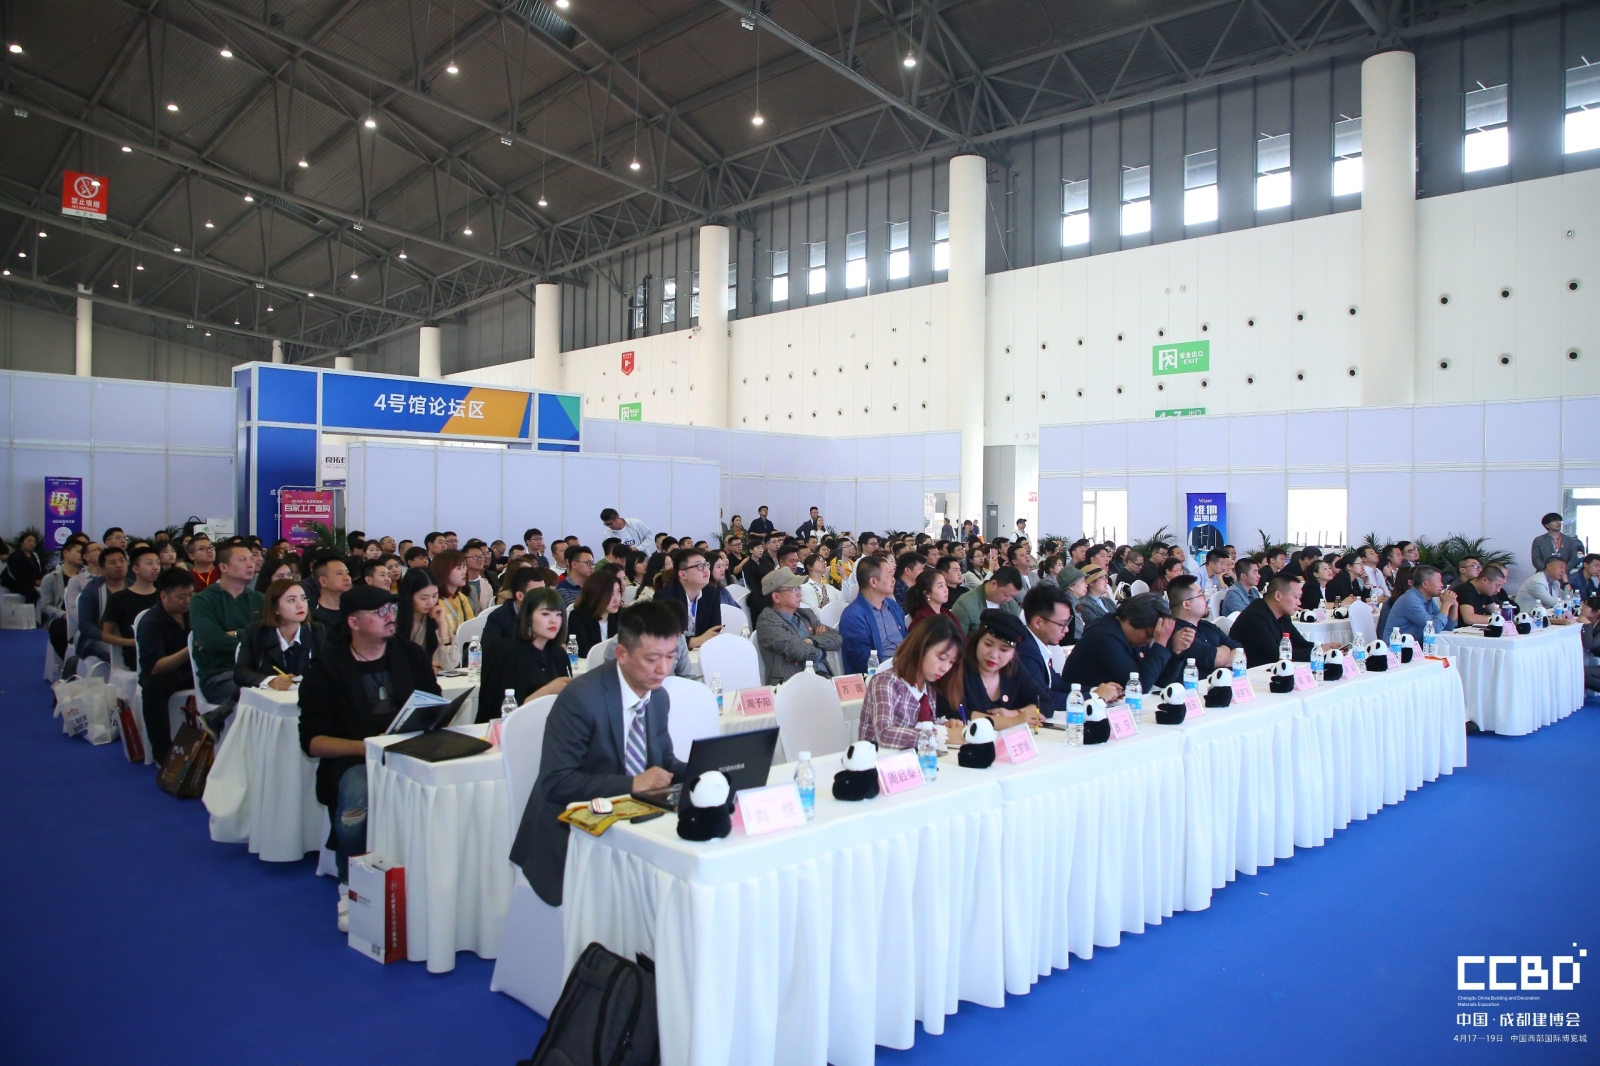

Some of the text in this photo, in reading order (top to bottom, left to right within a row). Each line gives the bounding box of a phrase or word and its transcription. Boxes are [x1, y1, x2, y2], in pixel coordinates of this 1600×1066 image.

[1179, 350, 1204, 360] 安全出口
[373, 393, 486, 419] 4号馆论坛区
[746, 697, 772, 710] 周予阳
